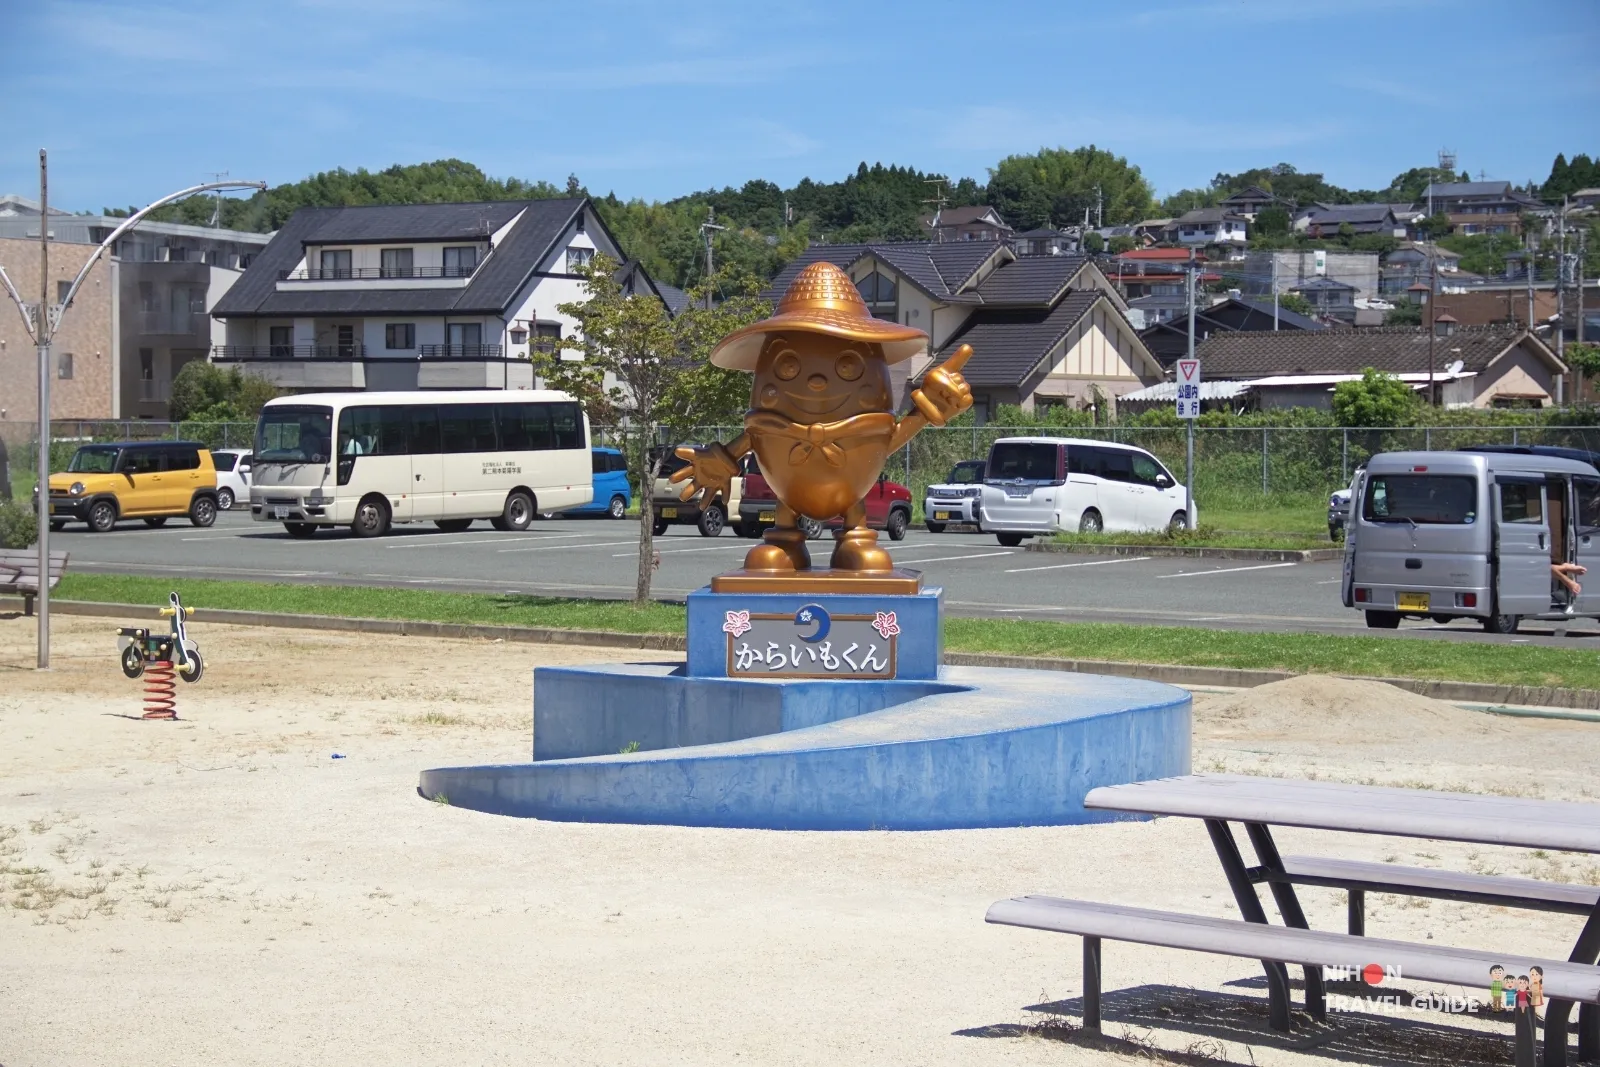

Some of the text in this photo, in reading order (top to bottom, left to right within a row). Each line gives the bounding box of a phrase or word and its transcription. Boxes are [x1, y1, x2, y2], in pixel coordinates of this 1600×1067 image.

[1178, 384, 1198, 399] 公園内
[735, 641, 888, 671] からいもくん
